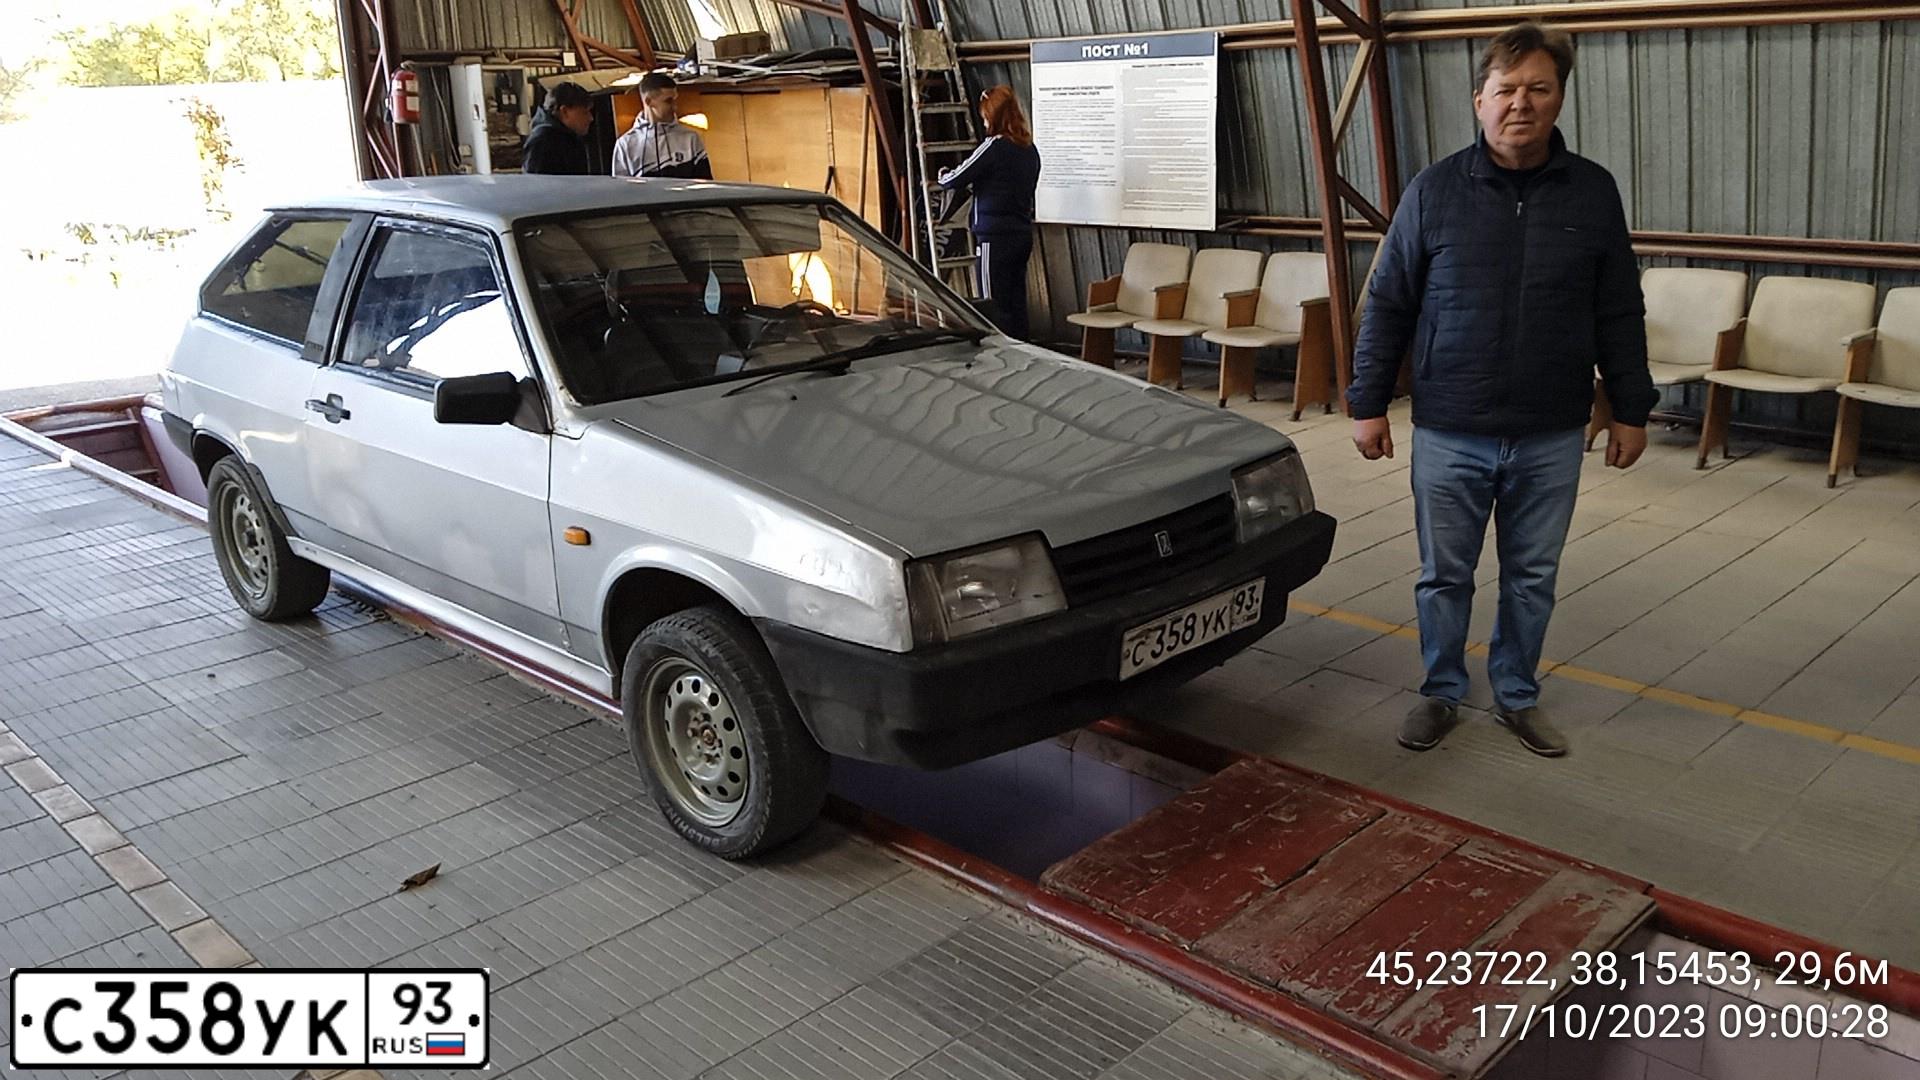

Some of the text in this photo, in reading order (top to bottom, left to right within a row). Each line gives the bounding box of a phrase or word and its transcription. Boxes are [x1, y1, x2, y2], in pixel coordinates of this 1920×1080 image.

[1082, 42, 1149, 58] ПОСТ №1
[1235, 584, 1257, 615] 93
[1132, 605, 1228, 667] С358УК
